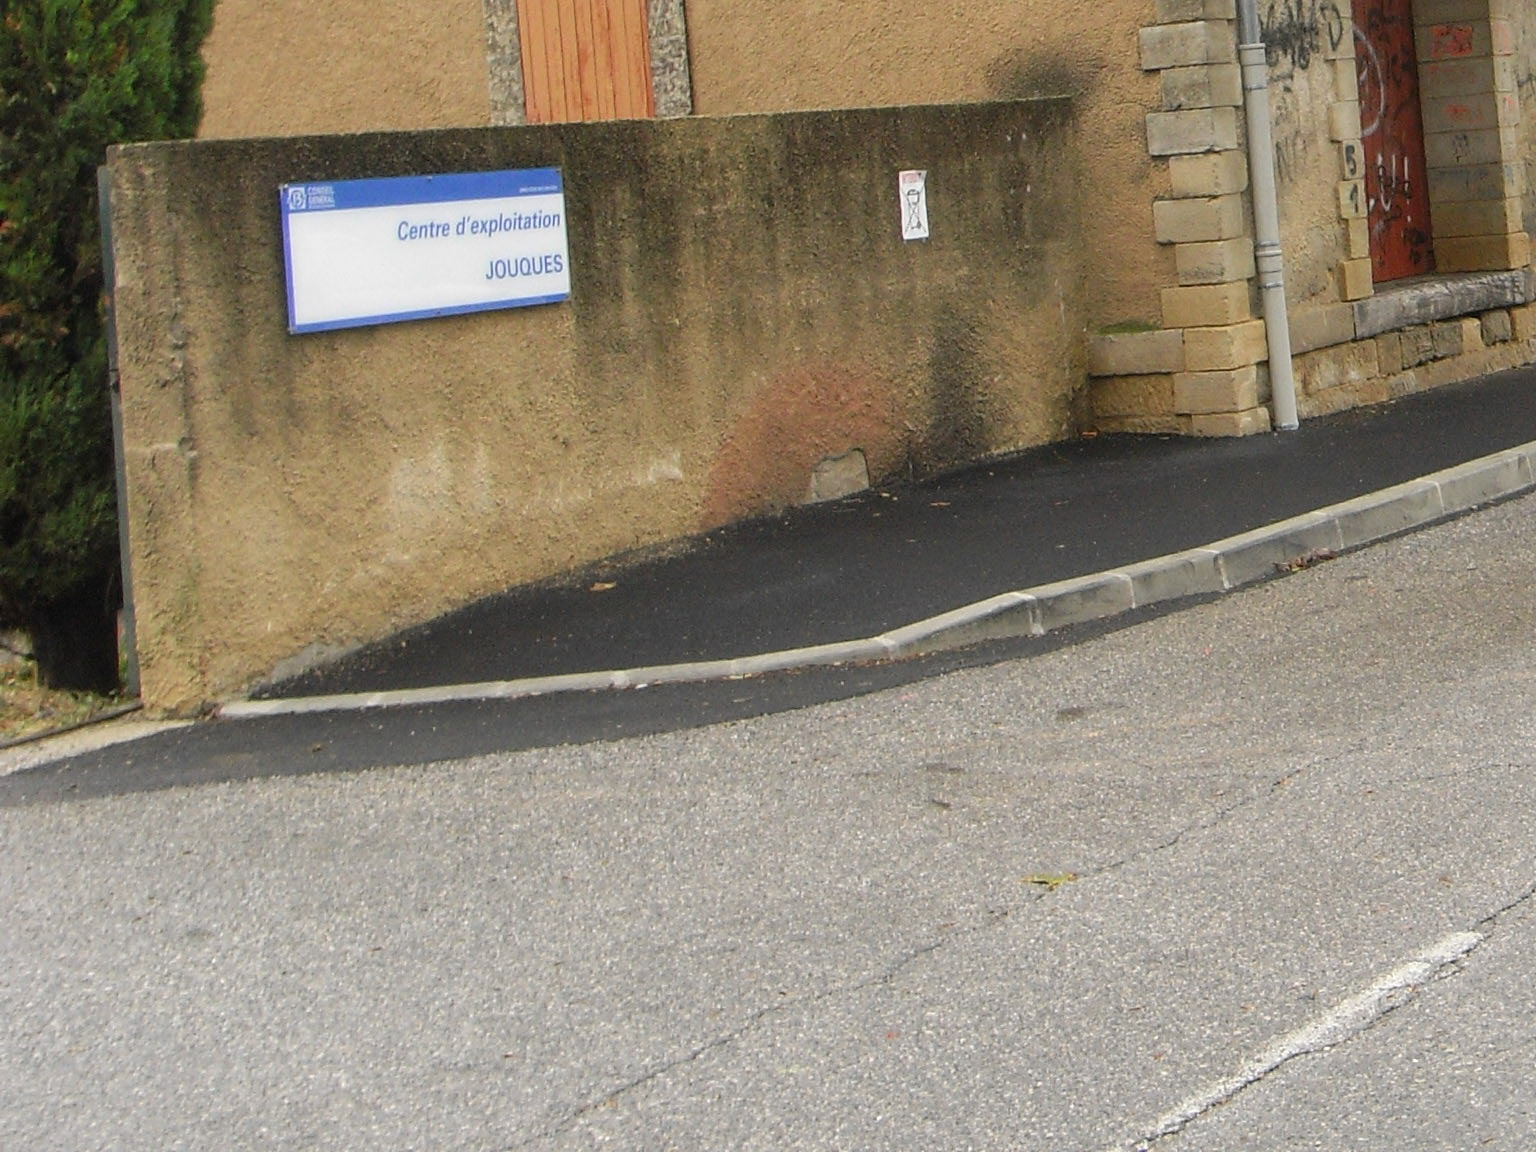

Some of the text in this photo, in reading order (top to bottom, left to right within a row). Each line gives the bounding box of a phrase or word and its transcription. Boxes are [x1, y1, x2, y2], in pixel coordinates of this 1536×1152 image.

[397, 209, 562, 241] Centre d'exploitation
[485, 253, 564, 280] JOUQUES
